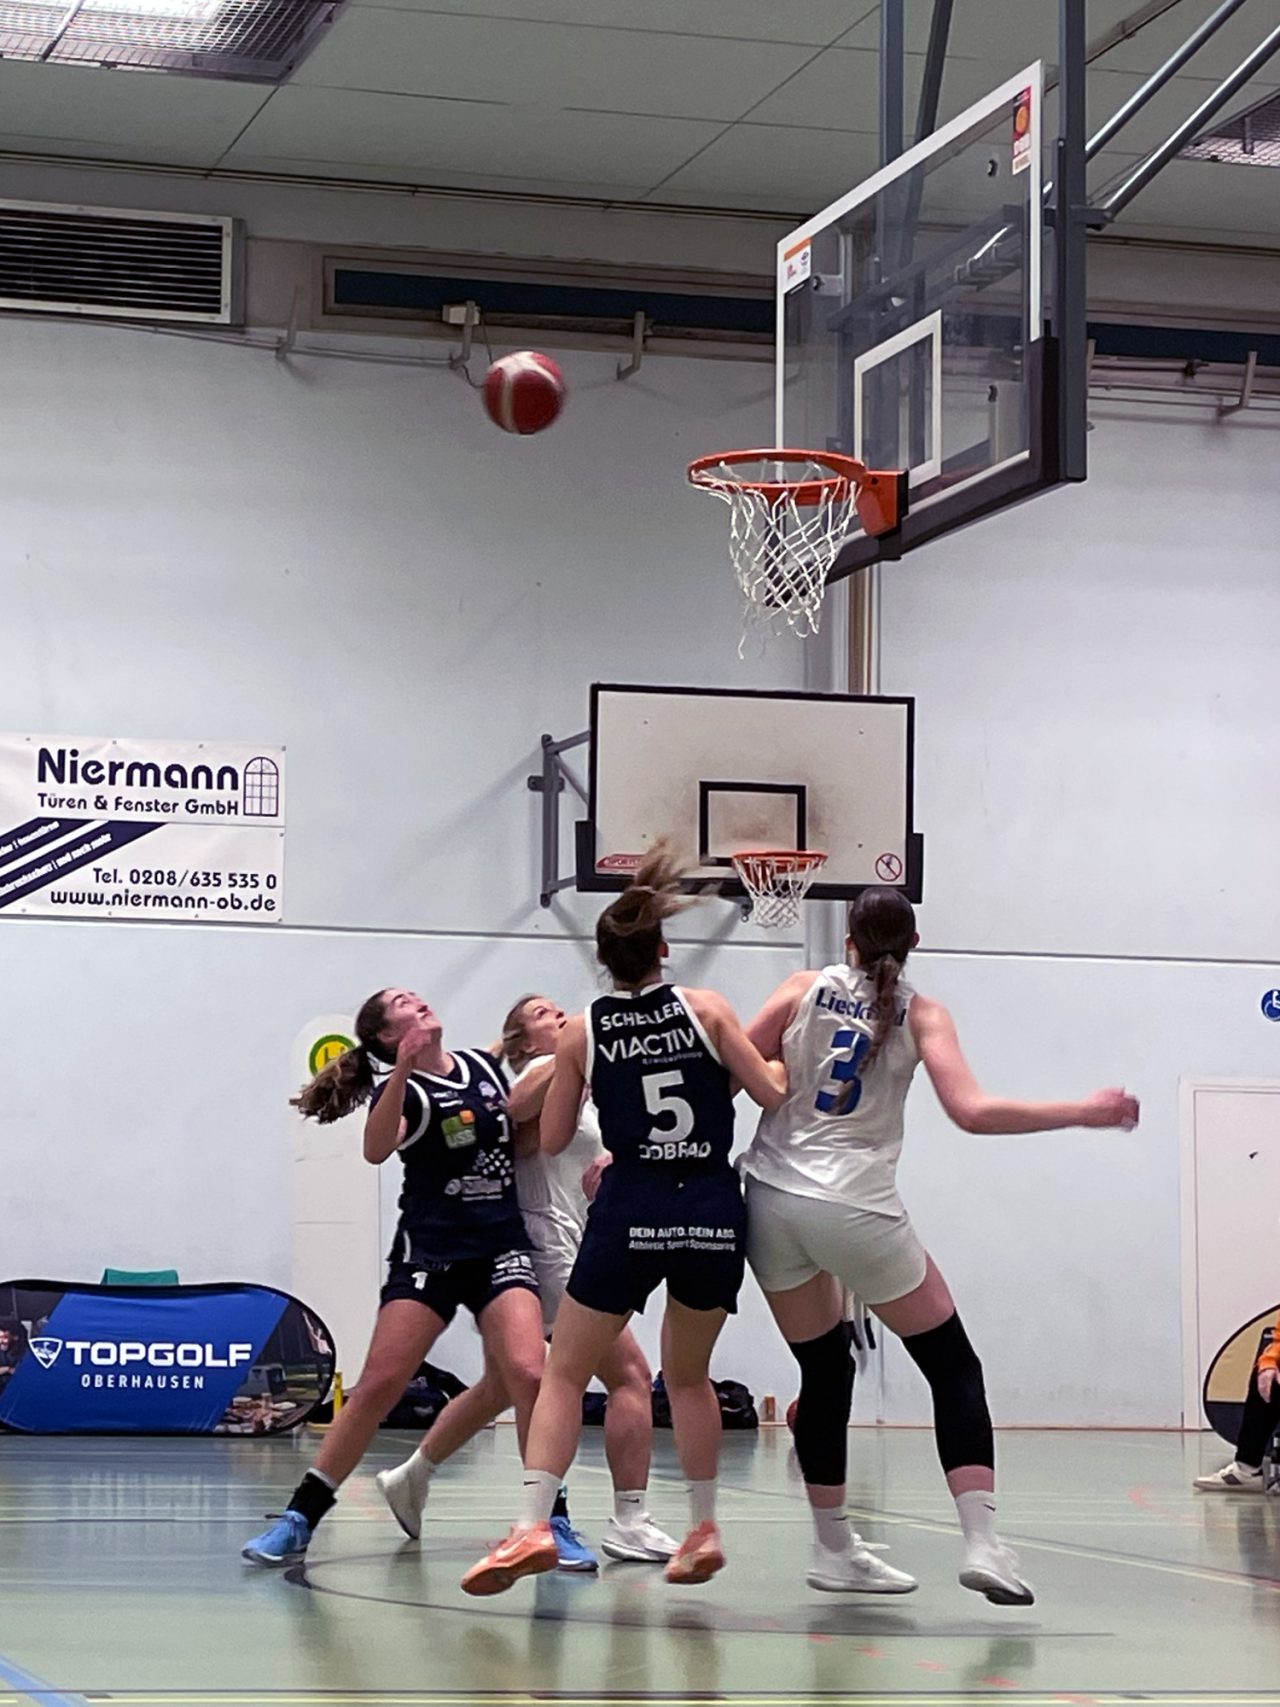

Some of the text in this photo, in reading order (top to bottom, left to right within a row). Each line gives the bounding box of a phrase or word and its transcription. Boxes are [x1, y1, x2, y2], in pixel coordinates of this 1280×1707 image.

[37, 747, 239, 790] Niermann
[37, 793, 87, 810] Türen
[94, 795, 108, 810] &
[185, 798, 238, 816] GmbH
[93, 867, 277, 889] Tel. 0208/635 535 0
[50, 889, 276, 912] www.niermann-ob.de
[600, 1001, 685, 1031] SCHELLER
[598, 1027, 695, 1063] VIACTIV
[814, 1030, 871, 1116] 3
[641, 1069, 695, 1144] 5
[66, 1341, 252, 1368] TOPGOLF
[80, 1374, 205, 1389] OBERHAUSEN
